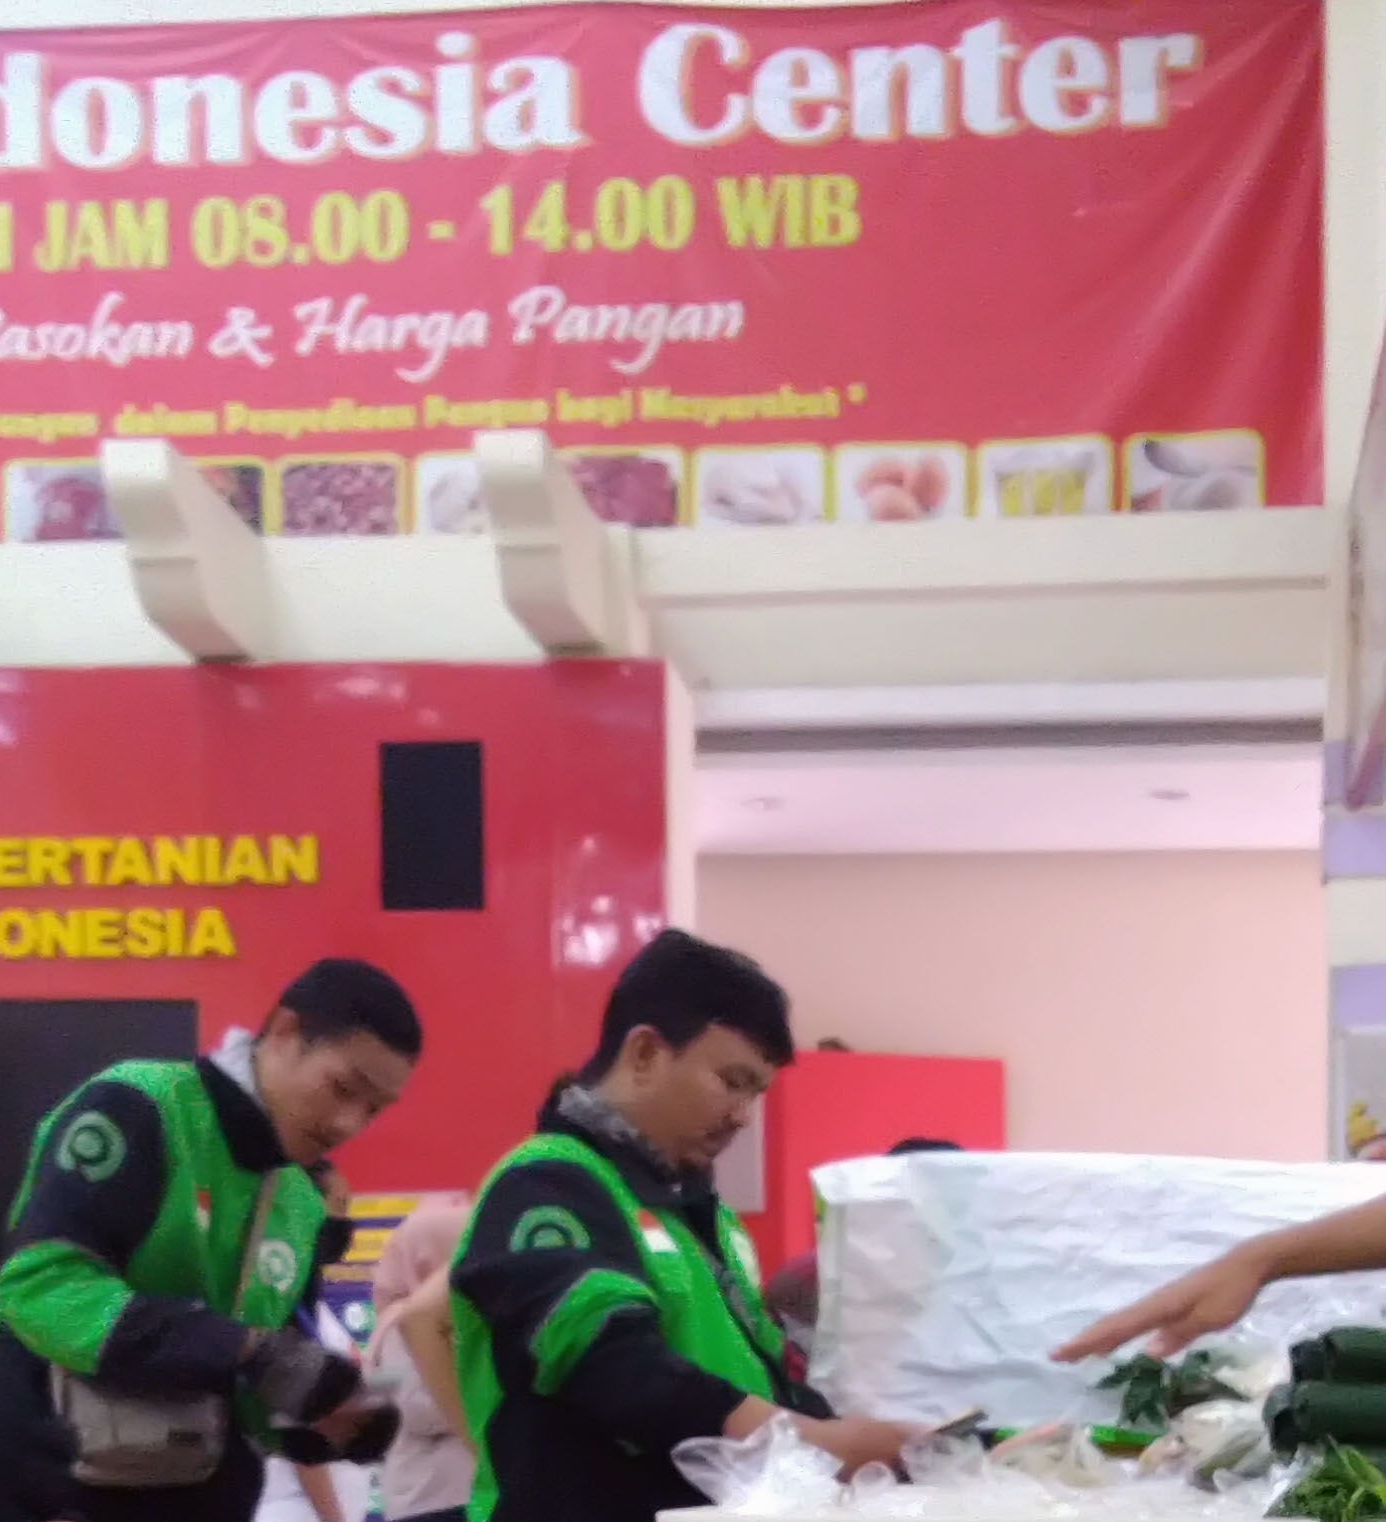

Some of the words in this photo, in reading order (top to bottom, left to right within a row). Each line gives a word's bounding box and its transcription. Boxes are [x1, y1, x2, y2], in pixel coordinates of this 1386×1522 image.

[638, 18, 1201, 145] Center
[34, 198, 169, 272] JAM
[191, 191, 409, 267] 08.00
[428, 221, 457, 240] -
[479, 176, 695, 256] 14.00
[716, 173, 861, 248] WIB
[208, 306, 273, 367] &
[294, 294, 489, 382] Harga
[508, 284, 745, 375] Pangan
